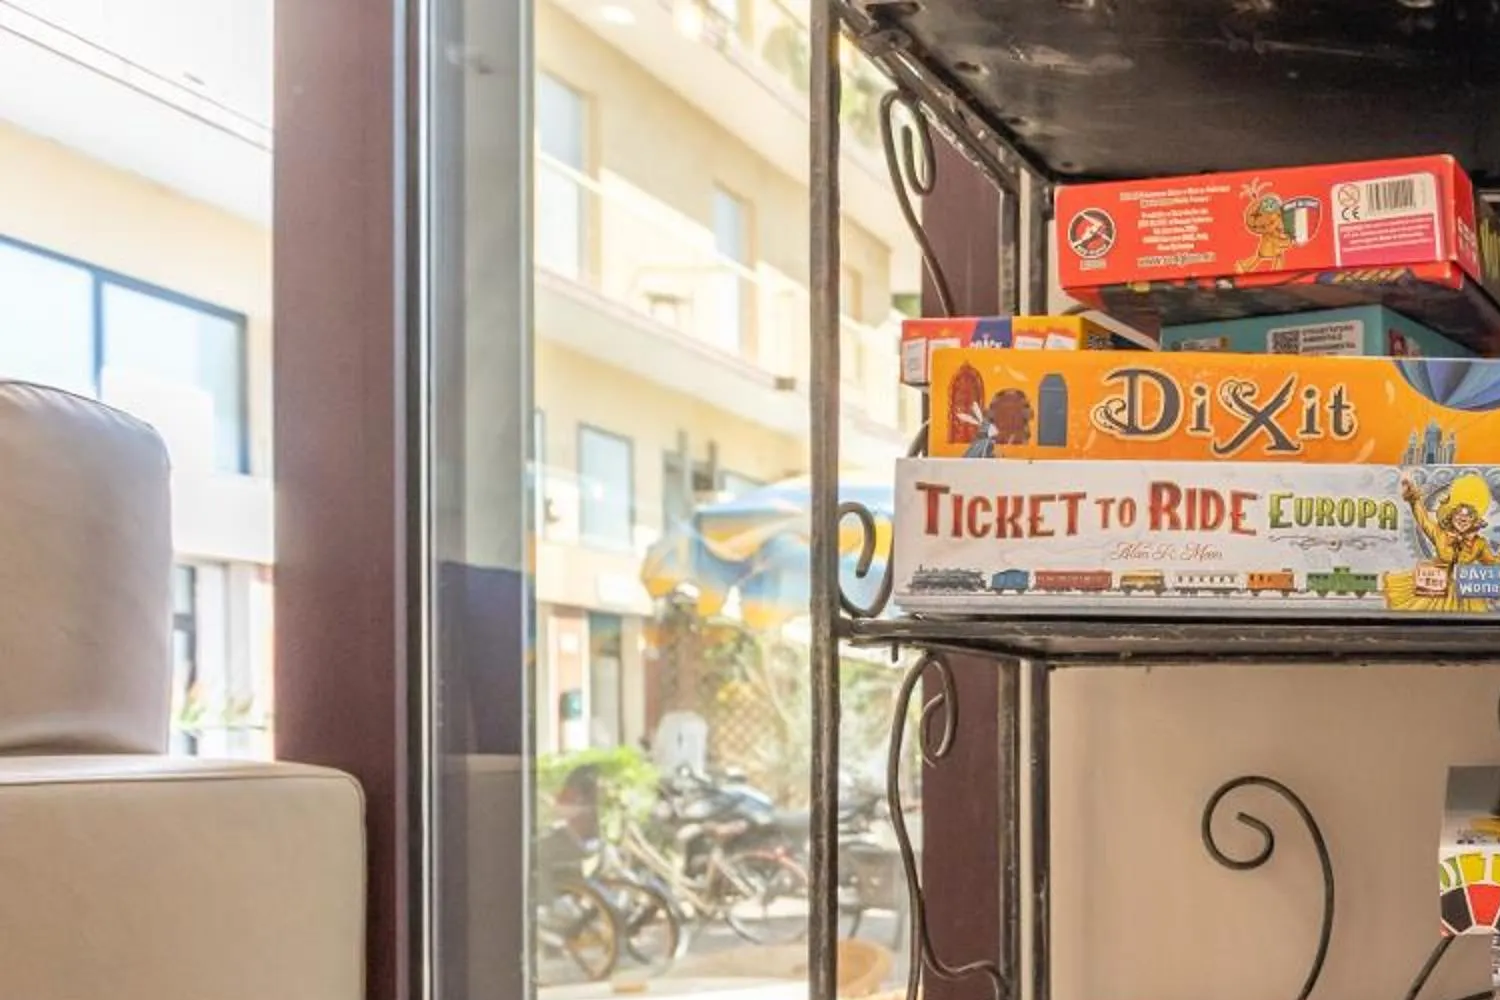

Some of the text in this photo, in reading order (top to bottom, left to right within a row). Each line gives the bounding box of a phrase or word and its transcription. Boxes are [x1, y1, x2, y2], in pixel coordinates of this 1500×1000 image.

[915, 480, 1398, 538] TICKET TO RIDE EUROPA
